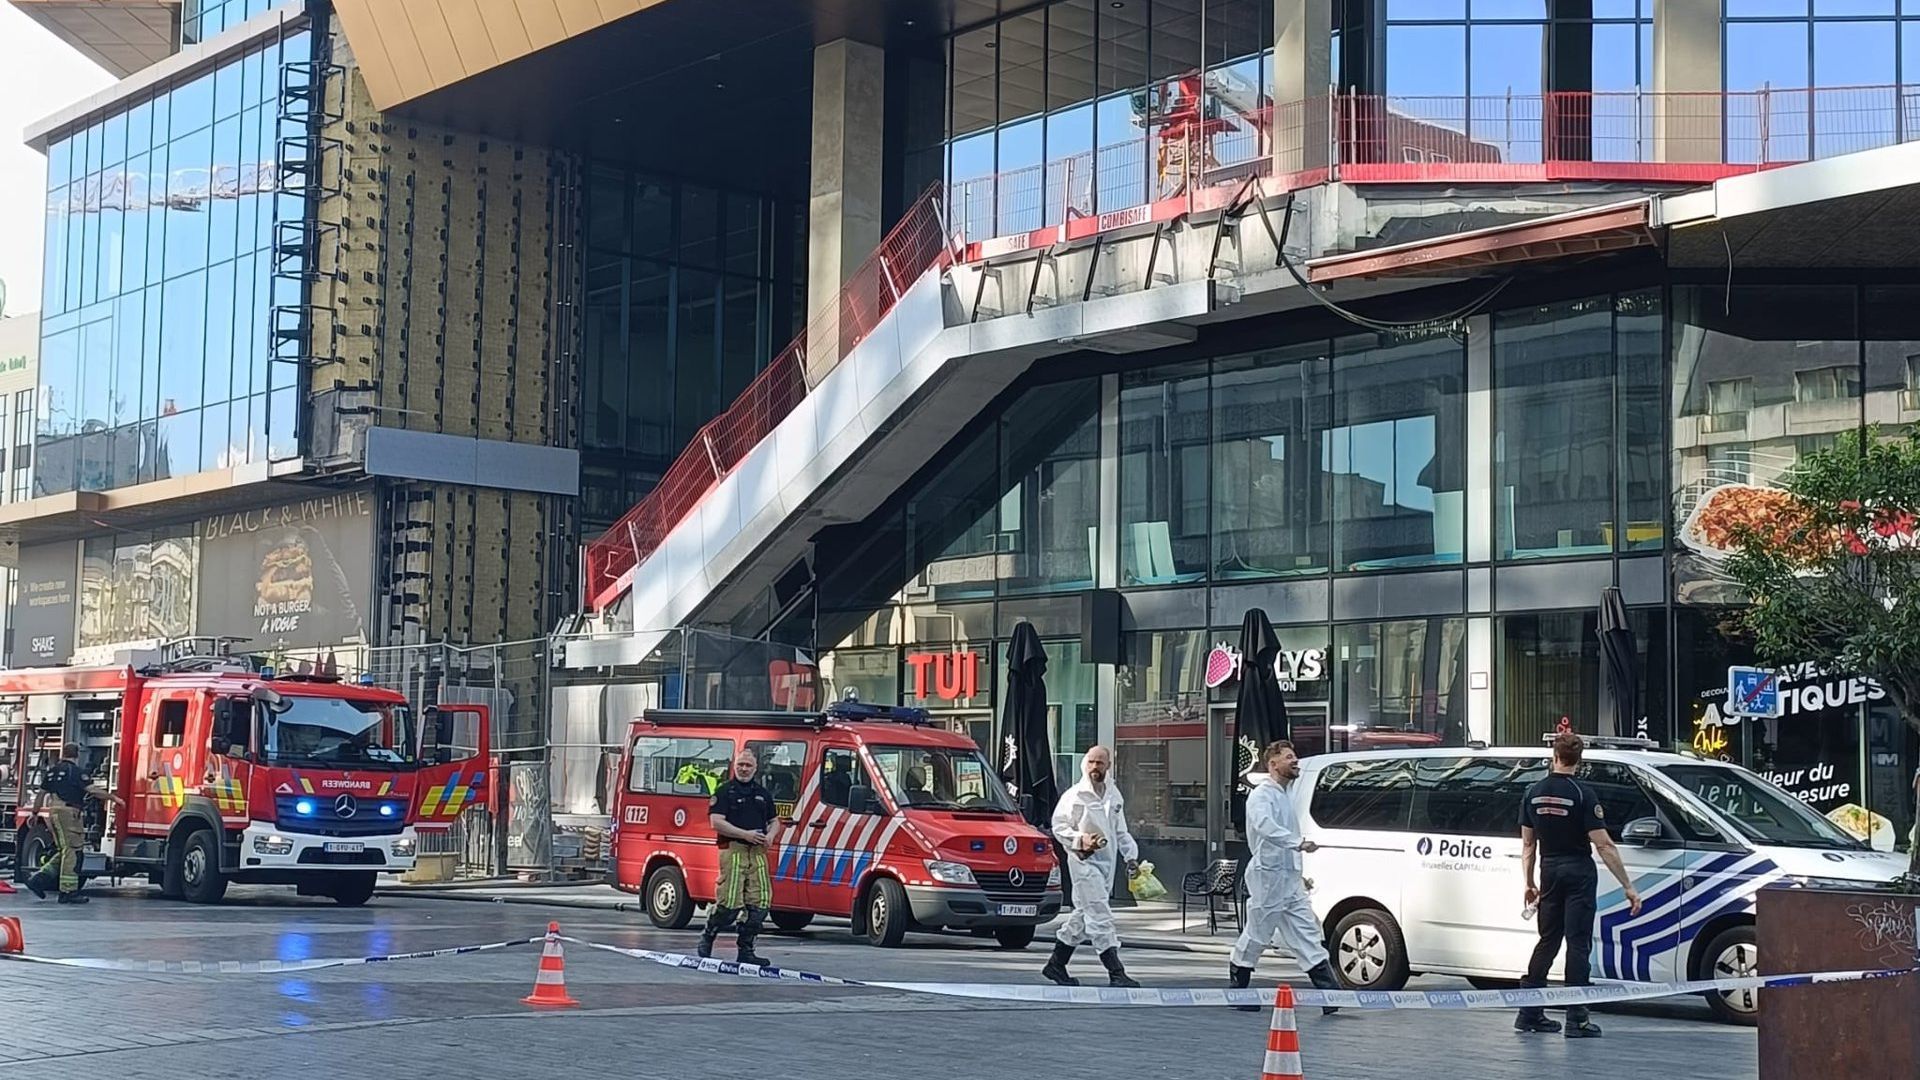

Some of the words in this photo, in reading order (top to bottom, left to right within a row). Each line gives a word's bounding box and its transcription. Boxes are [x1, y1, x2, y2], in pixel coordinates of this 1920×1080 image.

[1101, 206, 1147, 230] COMBISAFE
[205, 507, 271, 540] BLACK
[254, 603, 269, 617] NOT
[907, 651, 977, 700] TUI
[1809, 762, 1834, 781] du
[630, 807, 647, 822] 112
[1439, 839, 1493, 859] Police
